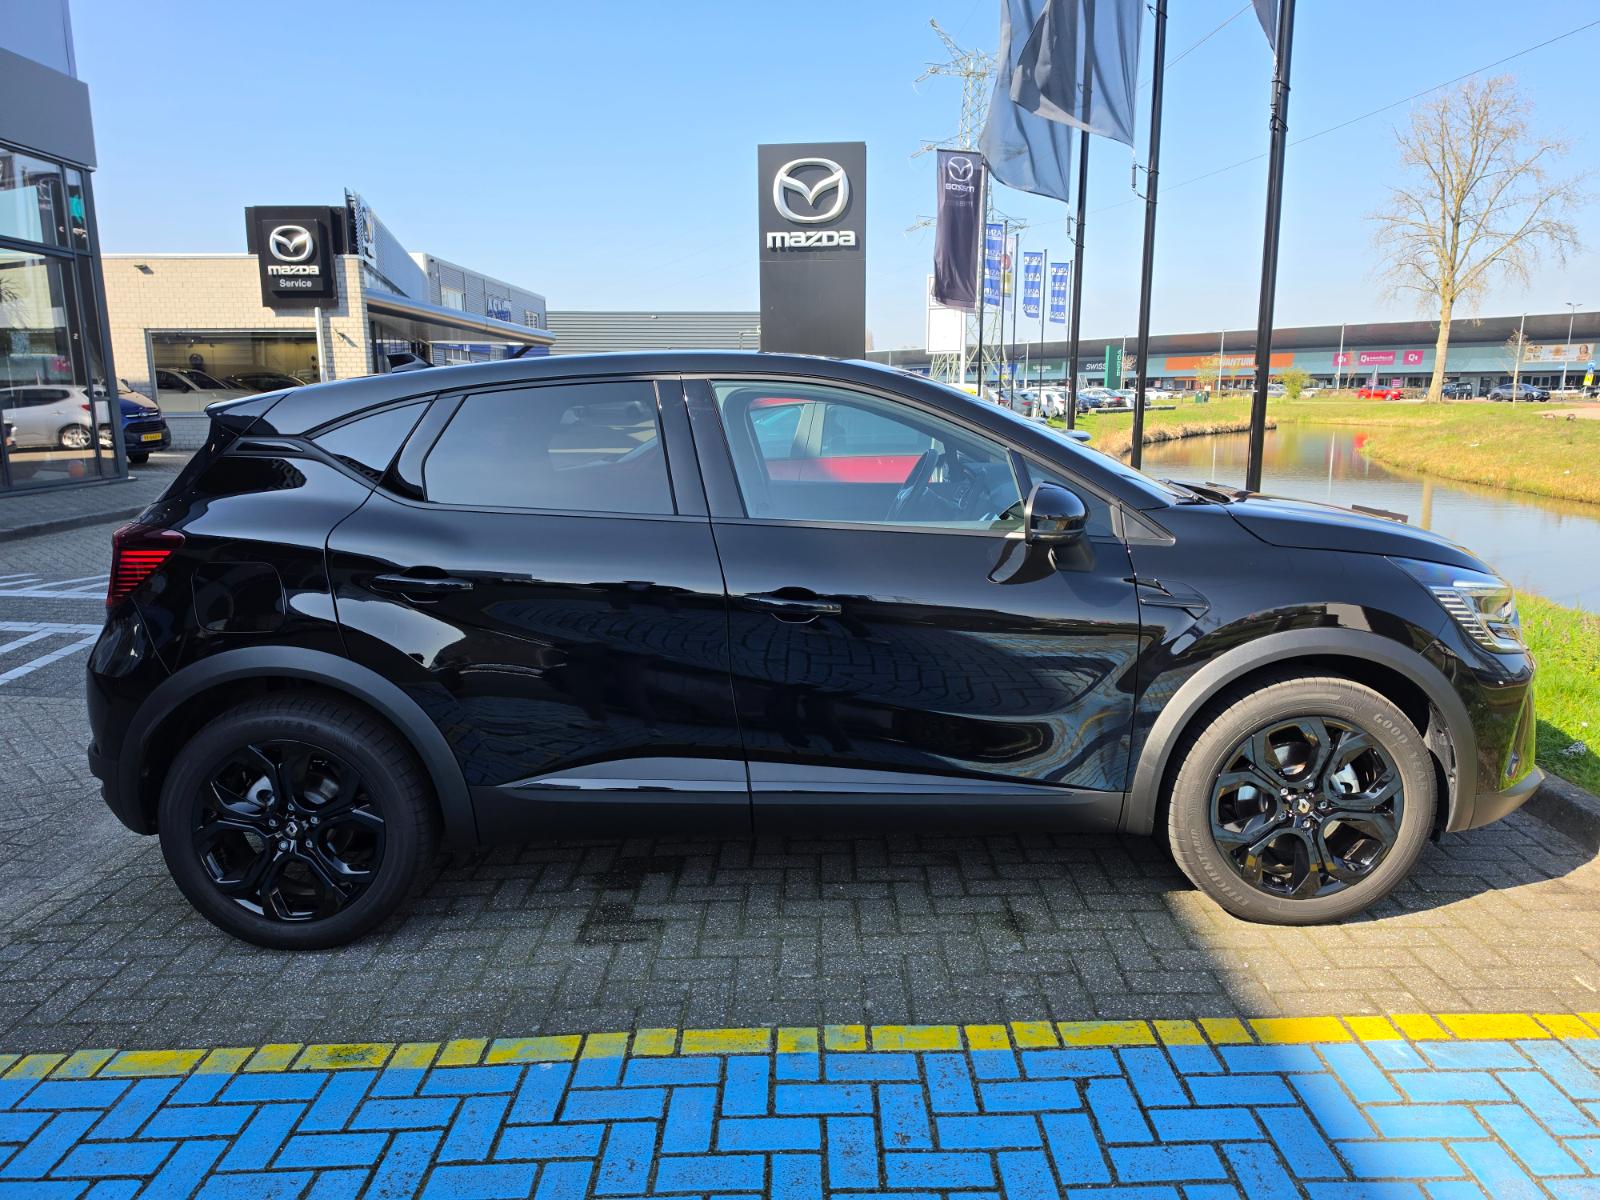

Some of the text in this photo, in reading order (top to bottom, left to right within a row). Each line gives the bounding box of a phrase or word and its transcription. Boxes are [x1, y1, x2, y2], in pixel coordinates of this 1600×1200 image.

[766, 231, 856, 249] mazda
[267, 265, 320, 276] mazda
[279, 278, 313, 288] Service
